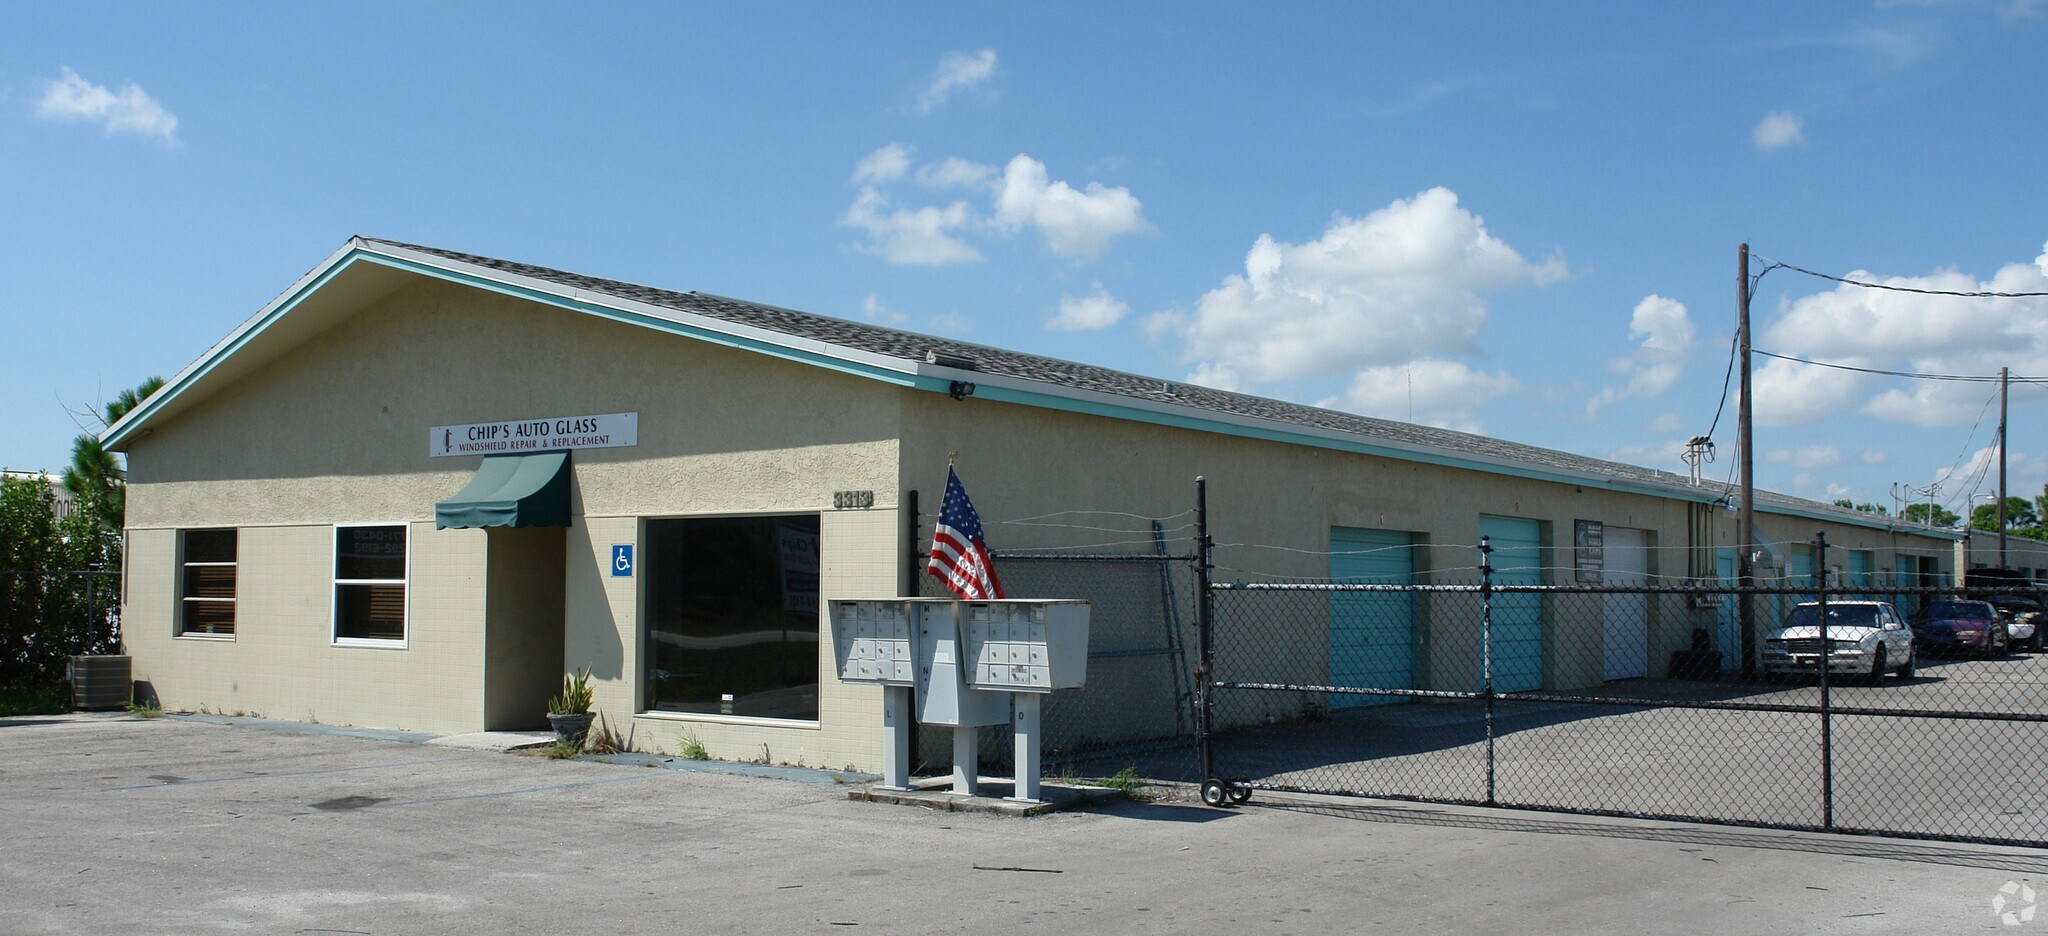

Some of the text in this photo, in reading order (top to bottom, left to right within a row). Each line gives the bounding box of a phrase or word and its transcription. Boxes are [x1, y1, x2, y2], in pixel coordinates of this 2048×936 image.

[468, 418, 598, 441] CHIP'S AUTO GLASS
[459, 435, 610, 452] WINDSHIELD REPAIR & REPLACEMENT
